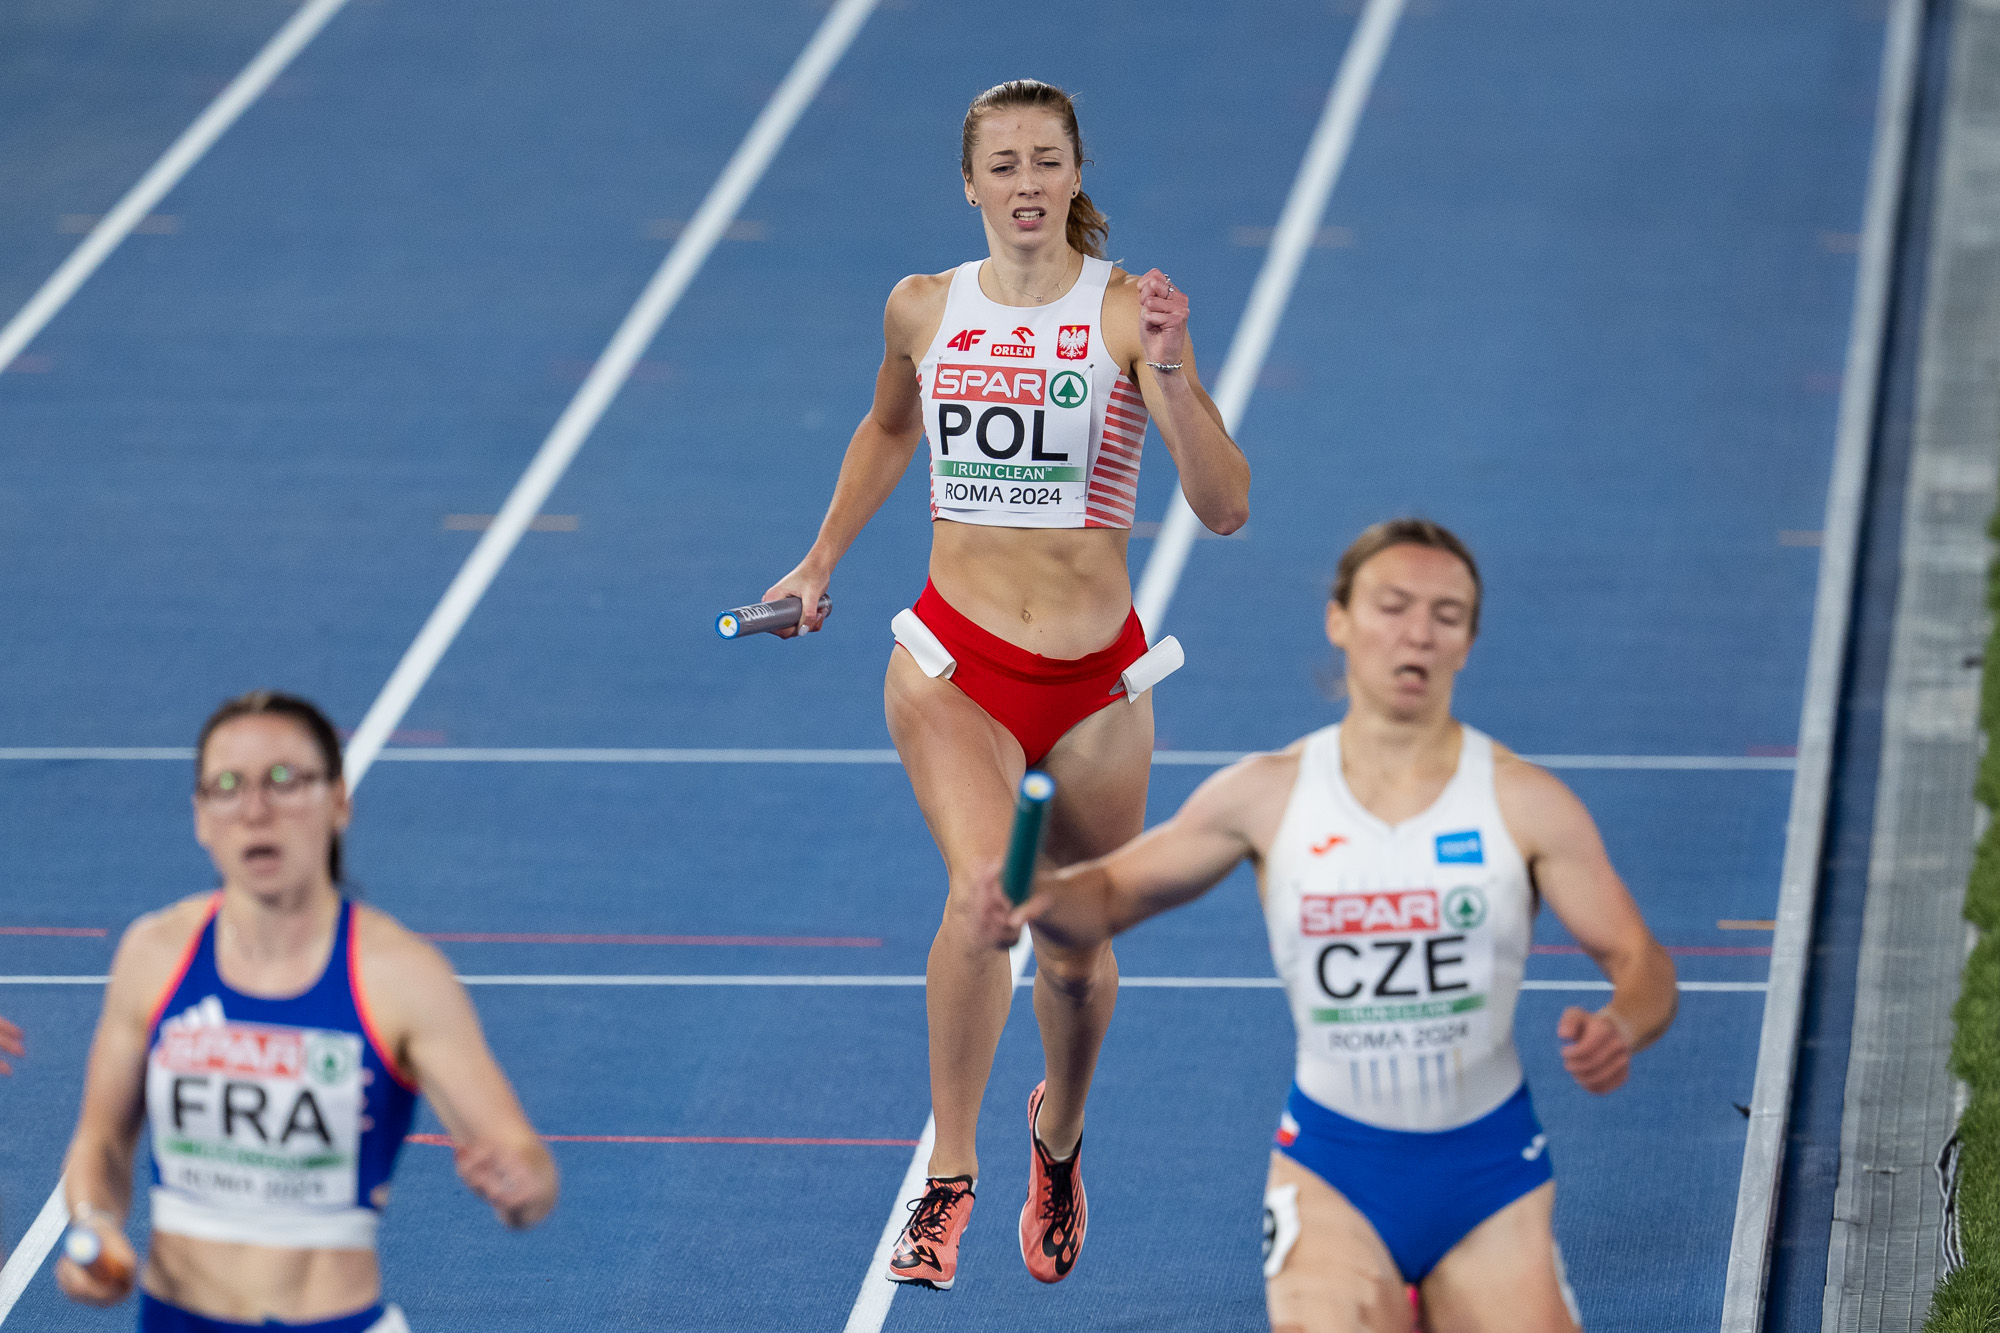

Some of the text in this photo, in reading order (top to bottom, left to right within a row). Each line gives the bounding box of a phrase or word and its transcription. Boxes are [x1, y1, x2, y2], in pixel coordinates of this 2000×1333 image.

[947, 329, 987, 351] 4F
[992, 345, 1033, 357] ORLEN
[936, 369, 1042, 400] SPAR
[939, 403, 1068, 461] POL
[959, 464, 992, 477] RUN
[945, 482, 1062, 505] ROMA 2024
[1303, 893, 1436, 932] SPAR
[1316, 935, 1469, 999] CZE
[172, 1076, 331, 1146] FRA
